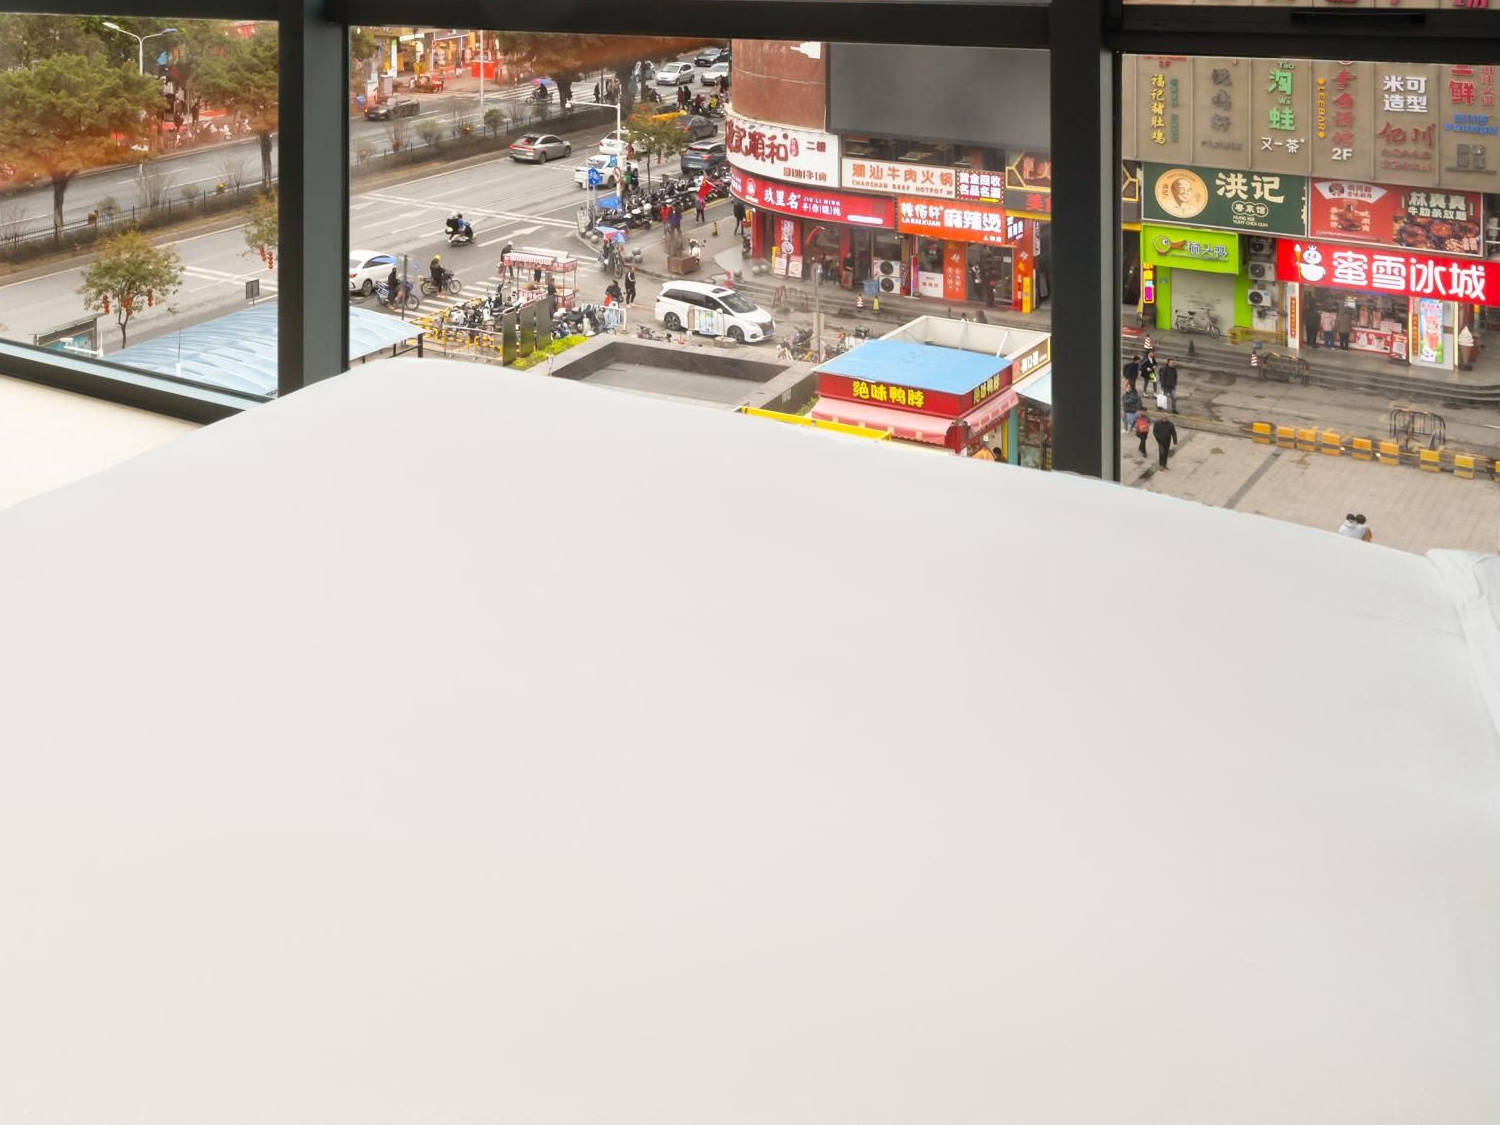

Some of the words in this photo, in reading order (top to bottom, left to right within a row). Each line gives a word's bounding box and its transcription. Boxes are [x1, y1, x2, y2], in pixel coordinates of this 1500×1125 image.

[1383, 75, 1427, 94] 米可
[1383, 94, 1428, 113] 造型
[1261, 137, 1301, 154] 又一茶
[1331, 147, 1353, 161] 2F
[1215, 172, 1284, 204] 洪记
[1332, 250, 1486, 301] 蜜雪冰城
[853, 380, 924, 408] 绝味鸭脖
